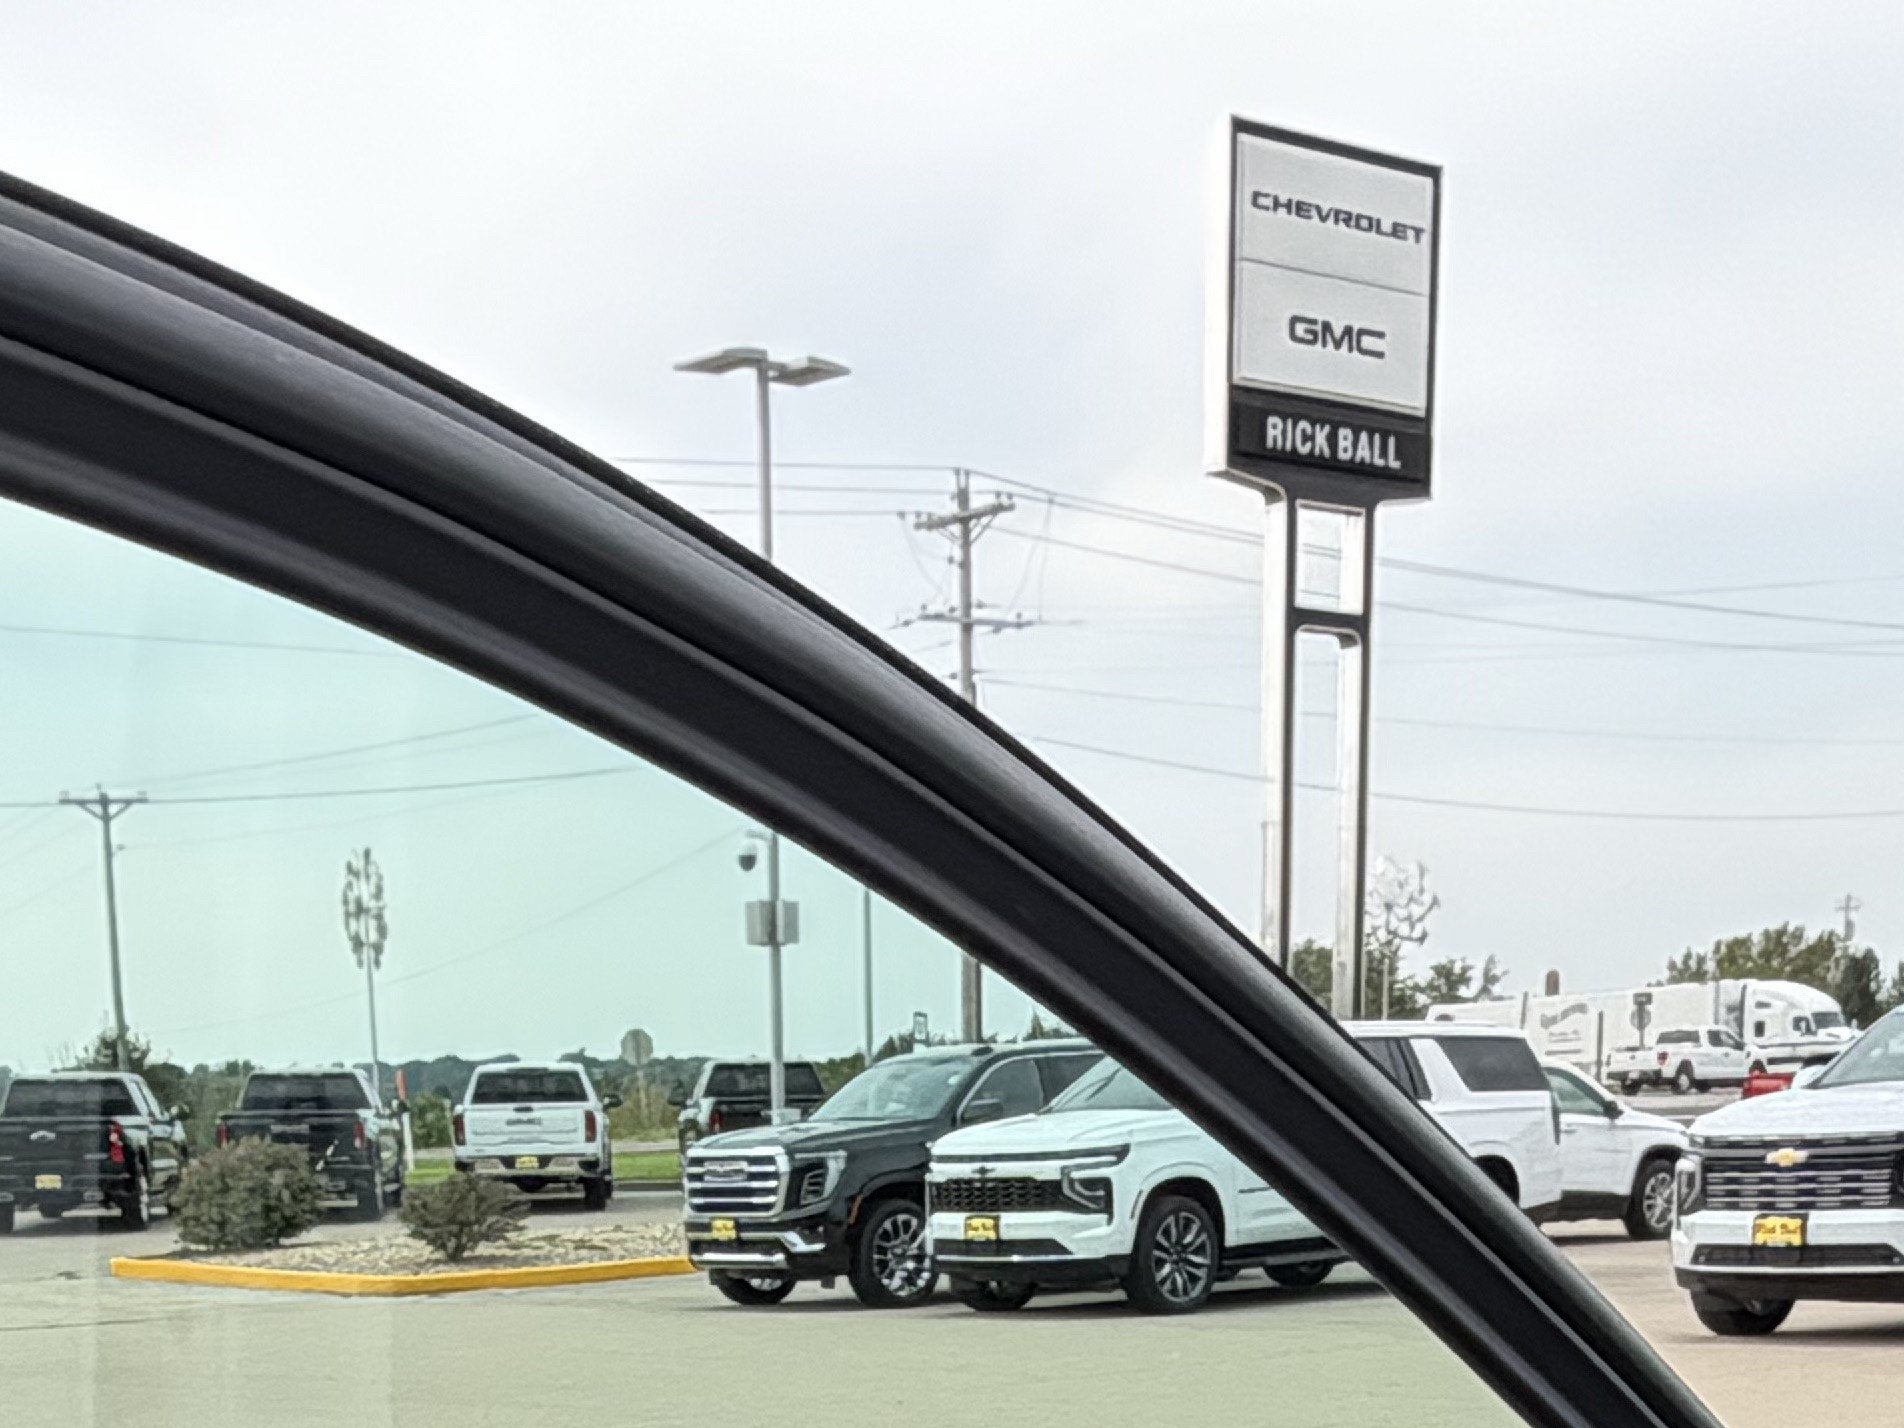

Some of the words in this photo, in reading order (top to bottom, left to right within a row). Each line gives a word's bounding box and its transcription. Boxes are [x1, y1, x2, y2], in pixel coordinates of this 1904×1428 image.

[1250, 189, 1426, 245] CHEVROLET
[1288, 313, 1387, 360] GMC
[1264, 414, 1331, 459] RICK
[1336, 426, 1402, 471] BALL
